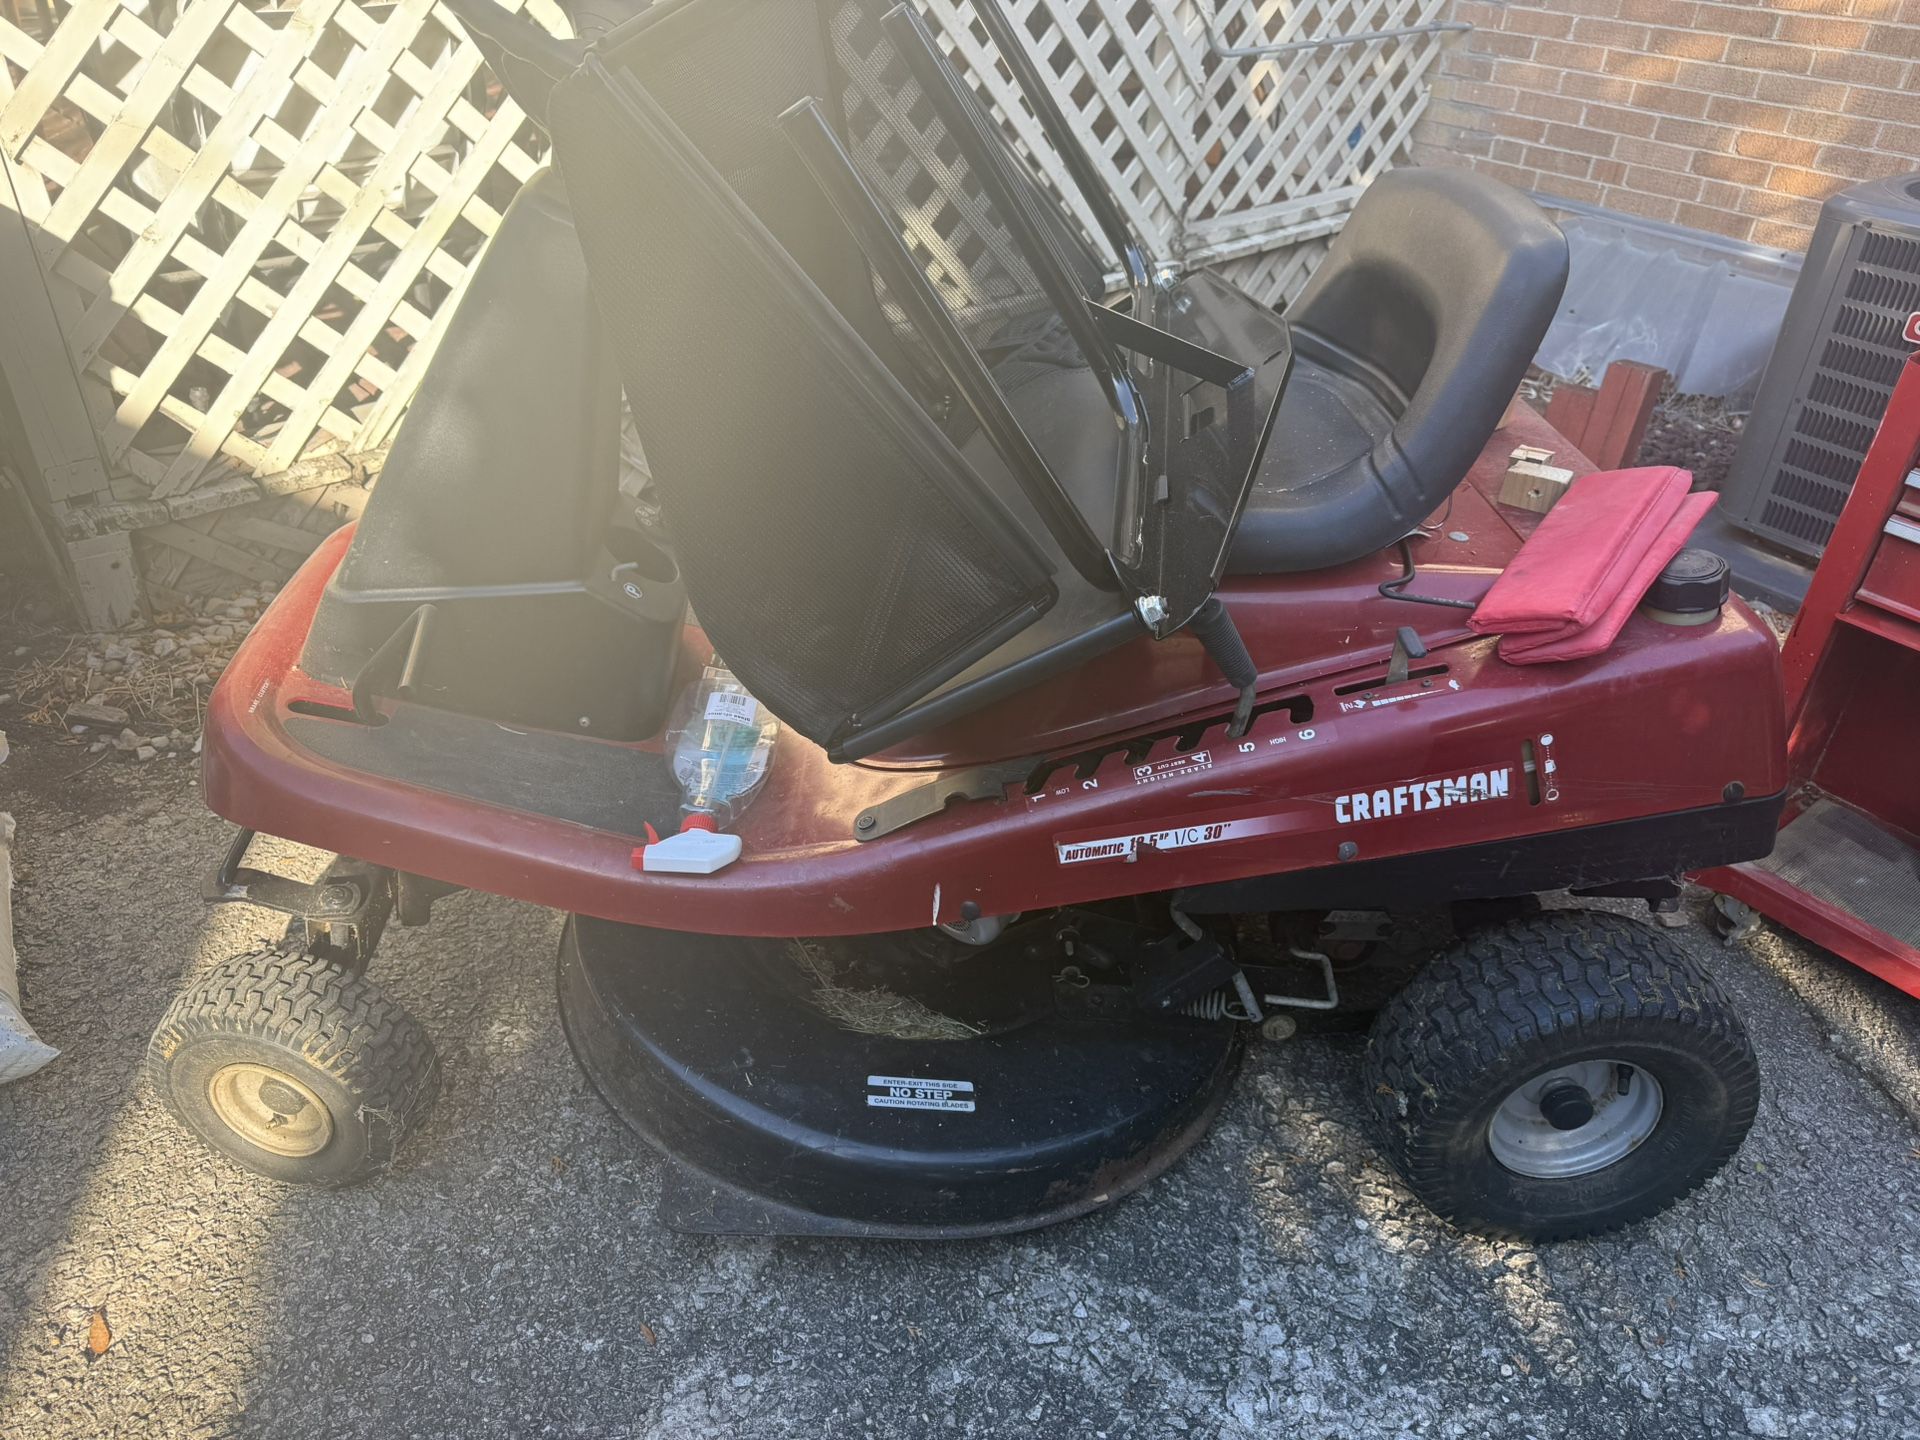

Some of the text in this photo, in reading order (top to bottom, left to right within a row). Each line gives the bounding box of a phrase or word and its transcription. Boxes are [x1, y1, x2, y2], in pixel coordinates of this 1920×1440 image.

[1298, 728, 1316, 741] 6
[1239, 741, 1256, 753] 5
[1269, 736, 1287, 746] HIGH
[1190, 751, 1208, 763] 4
[1136, 764, 1152, 777] 3
[1157, 759, 1186, 770] BEST CUT
[1137, 764, 1213, 784] BLADE HEIGHT
[1082, 778, 1098, 790] 2
[1055, 786, 1070, 796] LOW
[1335, 767, 1509, 824] CRAFTSMAN
[1031, 792, 1047, 803] 1
[1064, 842, 1125, 861] AUTOMATIC
[883, 1079, 923, 1087] ENTER-EXIT
[889, 1087, 953, 1100] NO STEP
[906, 1099, 940, 1108] ROTATING
[941, 1101, 969, 1109] BLADES
